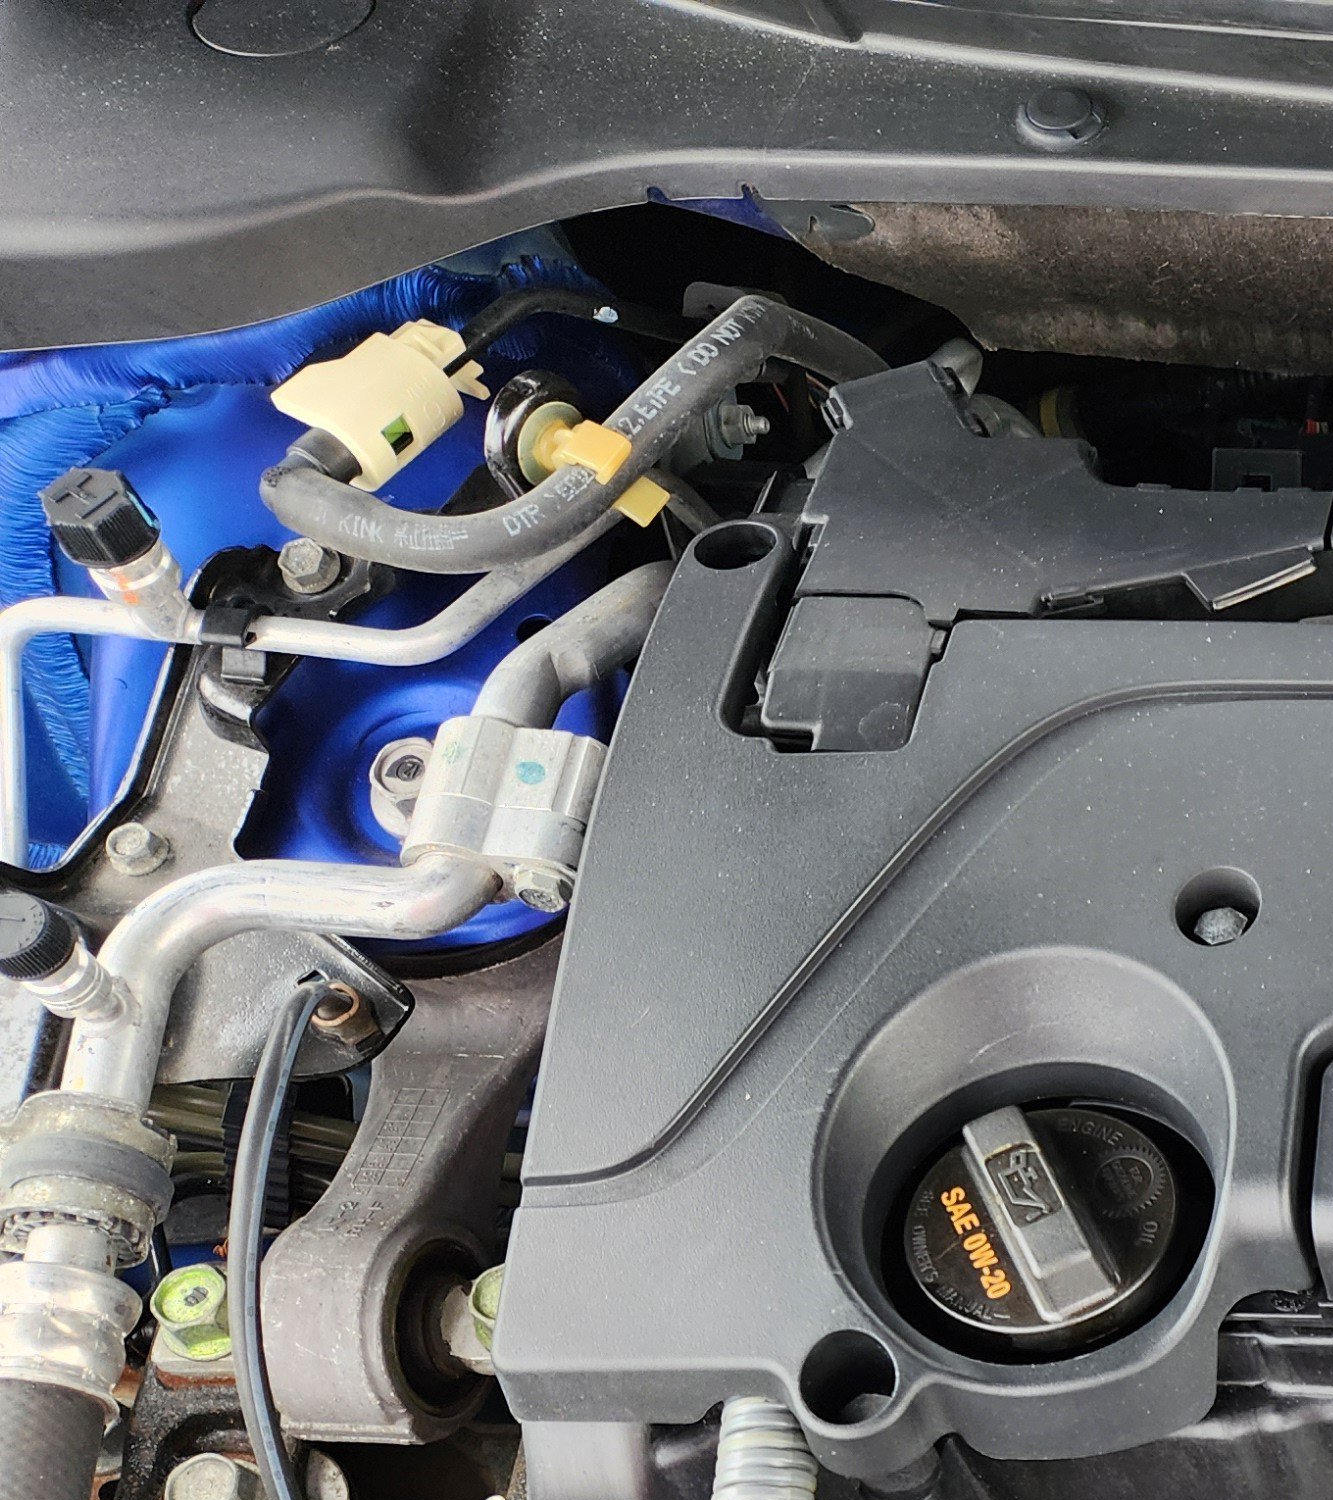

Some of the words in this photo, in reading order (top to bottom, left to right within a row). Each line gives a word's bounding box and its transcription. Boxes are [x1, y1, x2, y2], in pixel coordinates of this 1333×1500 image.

[1058, 1117, 1124, 1147] ENGINE
[940, 1185, 981, 1235] SAE
[962, 1231, 1012, 1300] 0W-20
